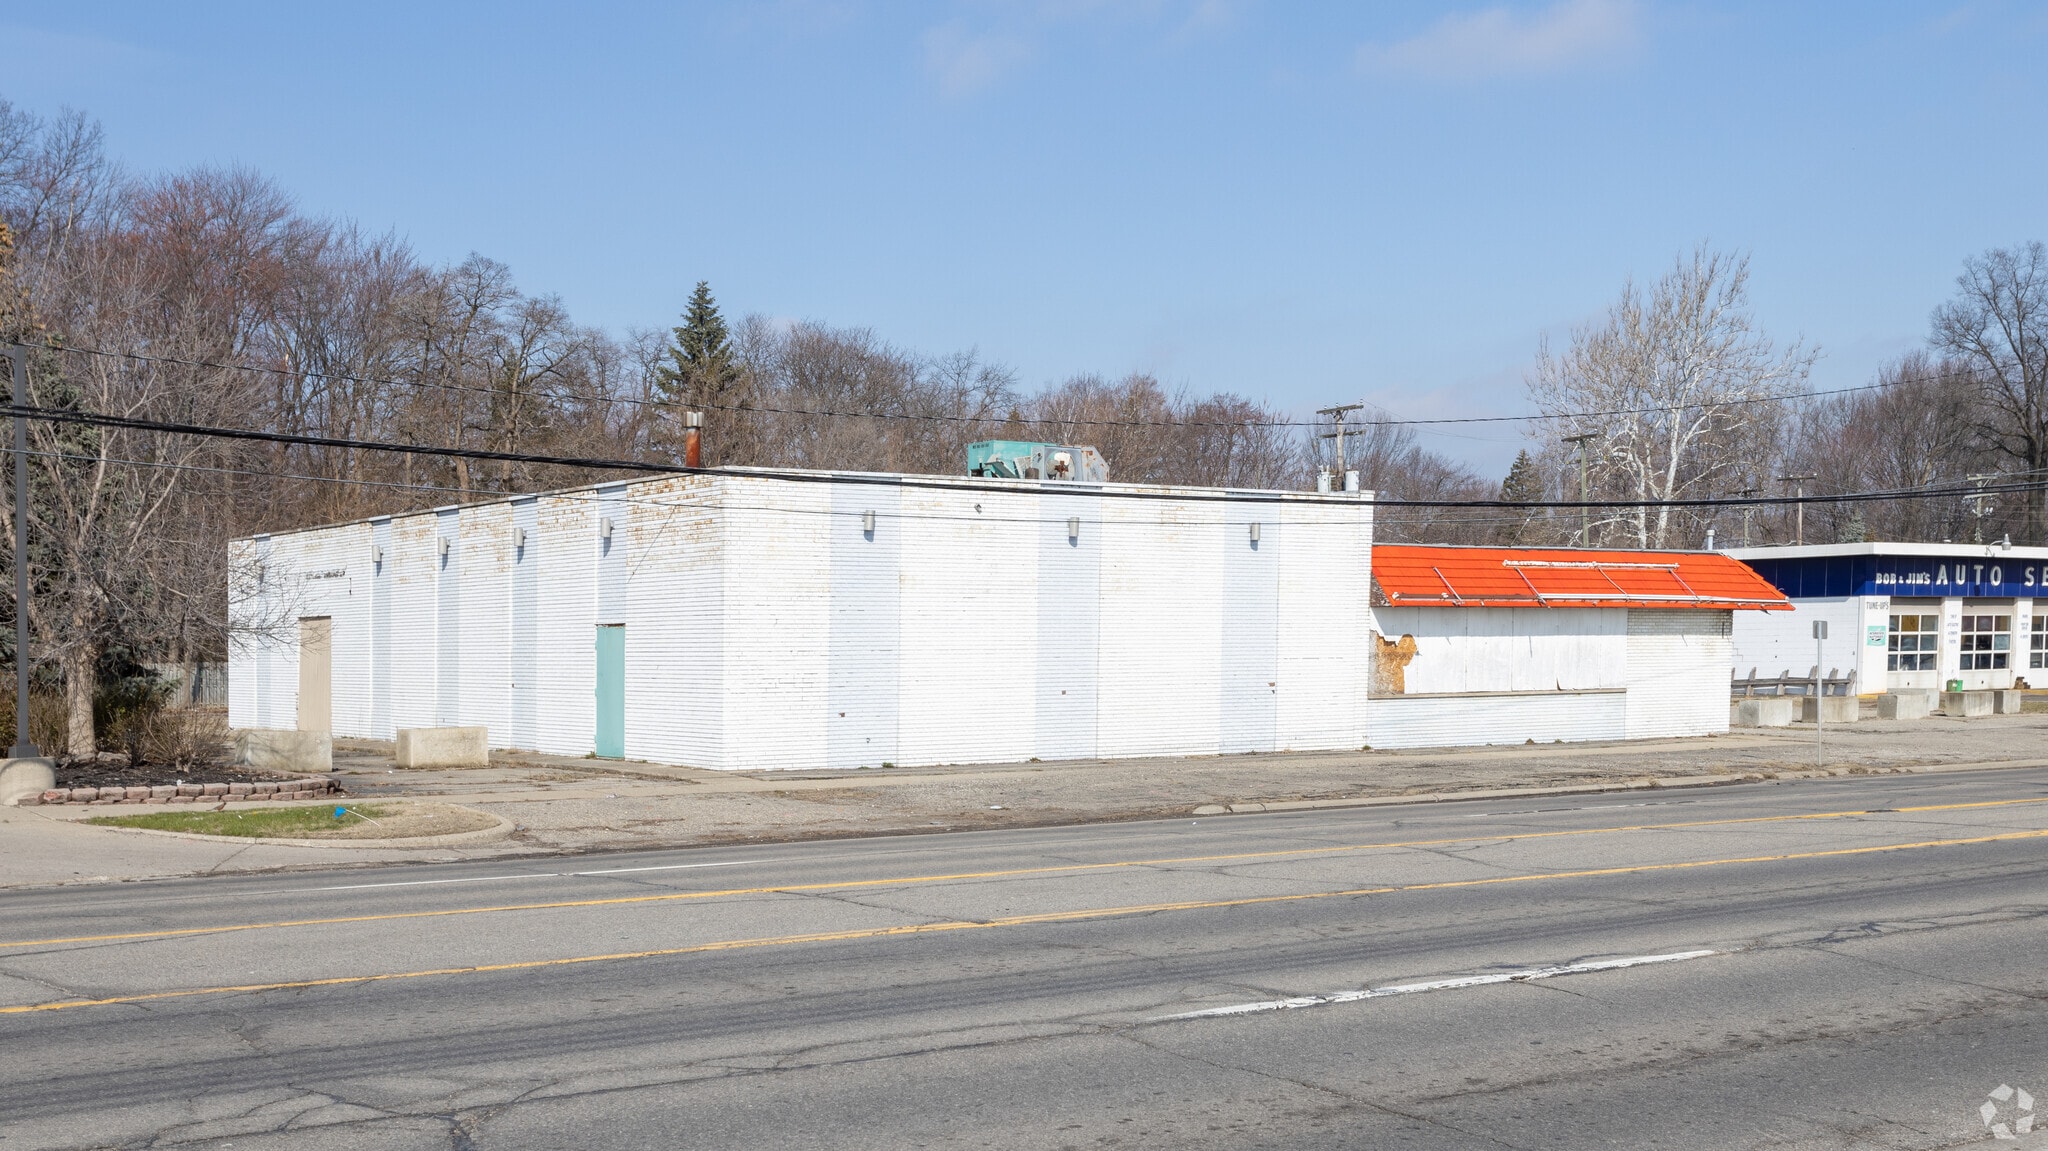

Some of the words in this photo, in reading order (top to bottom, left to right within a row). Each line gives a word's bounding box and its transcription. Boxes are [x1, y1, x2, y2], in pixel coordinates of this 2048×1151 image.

[1876, 573, 1896, 585] BOB
[1898, 576, 1904, 584] &
[1905, 572, 1931, 585] JIM'S
[1936, 564, 2002, 586] AUTO
[2024, 566, 2048, 587] SE
